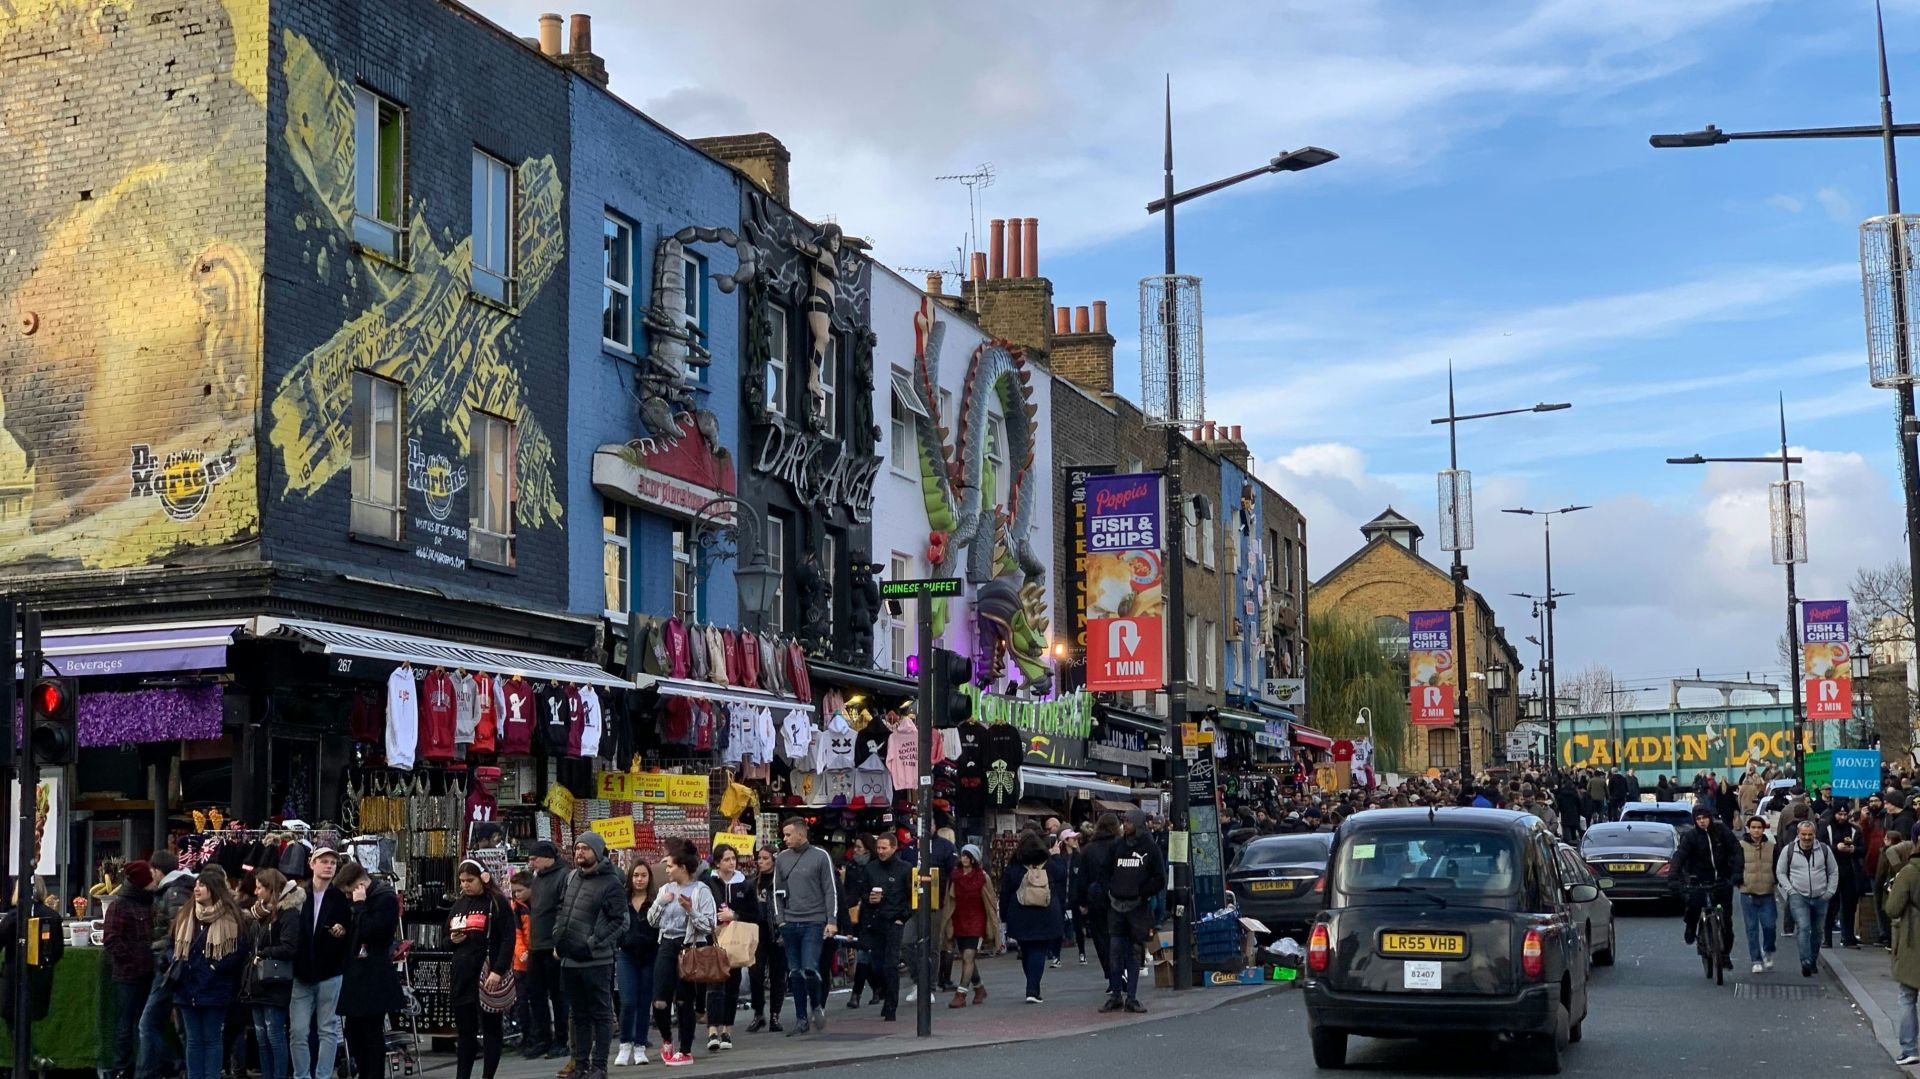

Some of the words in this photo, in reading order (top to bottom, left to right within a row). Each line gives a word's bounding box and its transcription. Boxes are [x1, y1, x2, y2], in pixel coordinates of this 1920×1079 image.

[755, 411, 822, 505] DARK
[130, 453, 237, 498] Martens
[407, 464, 469, 493] Martens
[1096, 481, 1148, 514] Poppies
[1091, 517, 1134, 533] FISH
[1138, 516, 1153, 531] &
[433, 535, 443, 546] OR
[1091, 531, 1154, 548] CHIPS
[883, 583, 920, 594] CHINESE
[1807, 624, 1833, 633] FISH
[1835, 624, 1844, 632] &
[1413, 632, 1437, 641] FISH
[1439, 632, 1448, 640] &
[1808, 632, 1845, 641] CHIPS
[1413, 640, 1448, 648] CHIPS
[66, 659, 123, 672] Beverages
[337, 658, 352, 672] 267
[1104, 661, 1111, 676] 1
[1116, 660, 1144, 676] MIN
[1817, 703, 1823, 711] 2
[1825, 702, 1842, 711] MIN
[1421, 709, 1427, 717] 2
[1429, 708, 1445, 717] MIN
[1563, 733, 1708, 768] CAMDEN
[1835, 757, 1877, 768] MONEY
[603, 774, 626, 793] £1
[1832, 779, 1880, 789] CHANGE
[678, 789, 691, 797] for
[693, 790, 704, 798] £5
[603, 829, 617, 838] for
[619, 828, 631, 836] £1
[1117, 858, 1140, 867] PUMA
[1390, 936, 1426, 950] LR55
[1430, 936, 1457, 950] VHB
[1411, 970, 1435, 979] 82407
